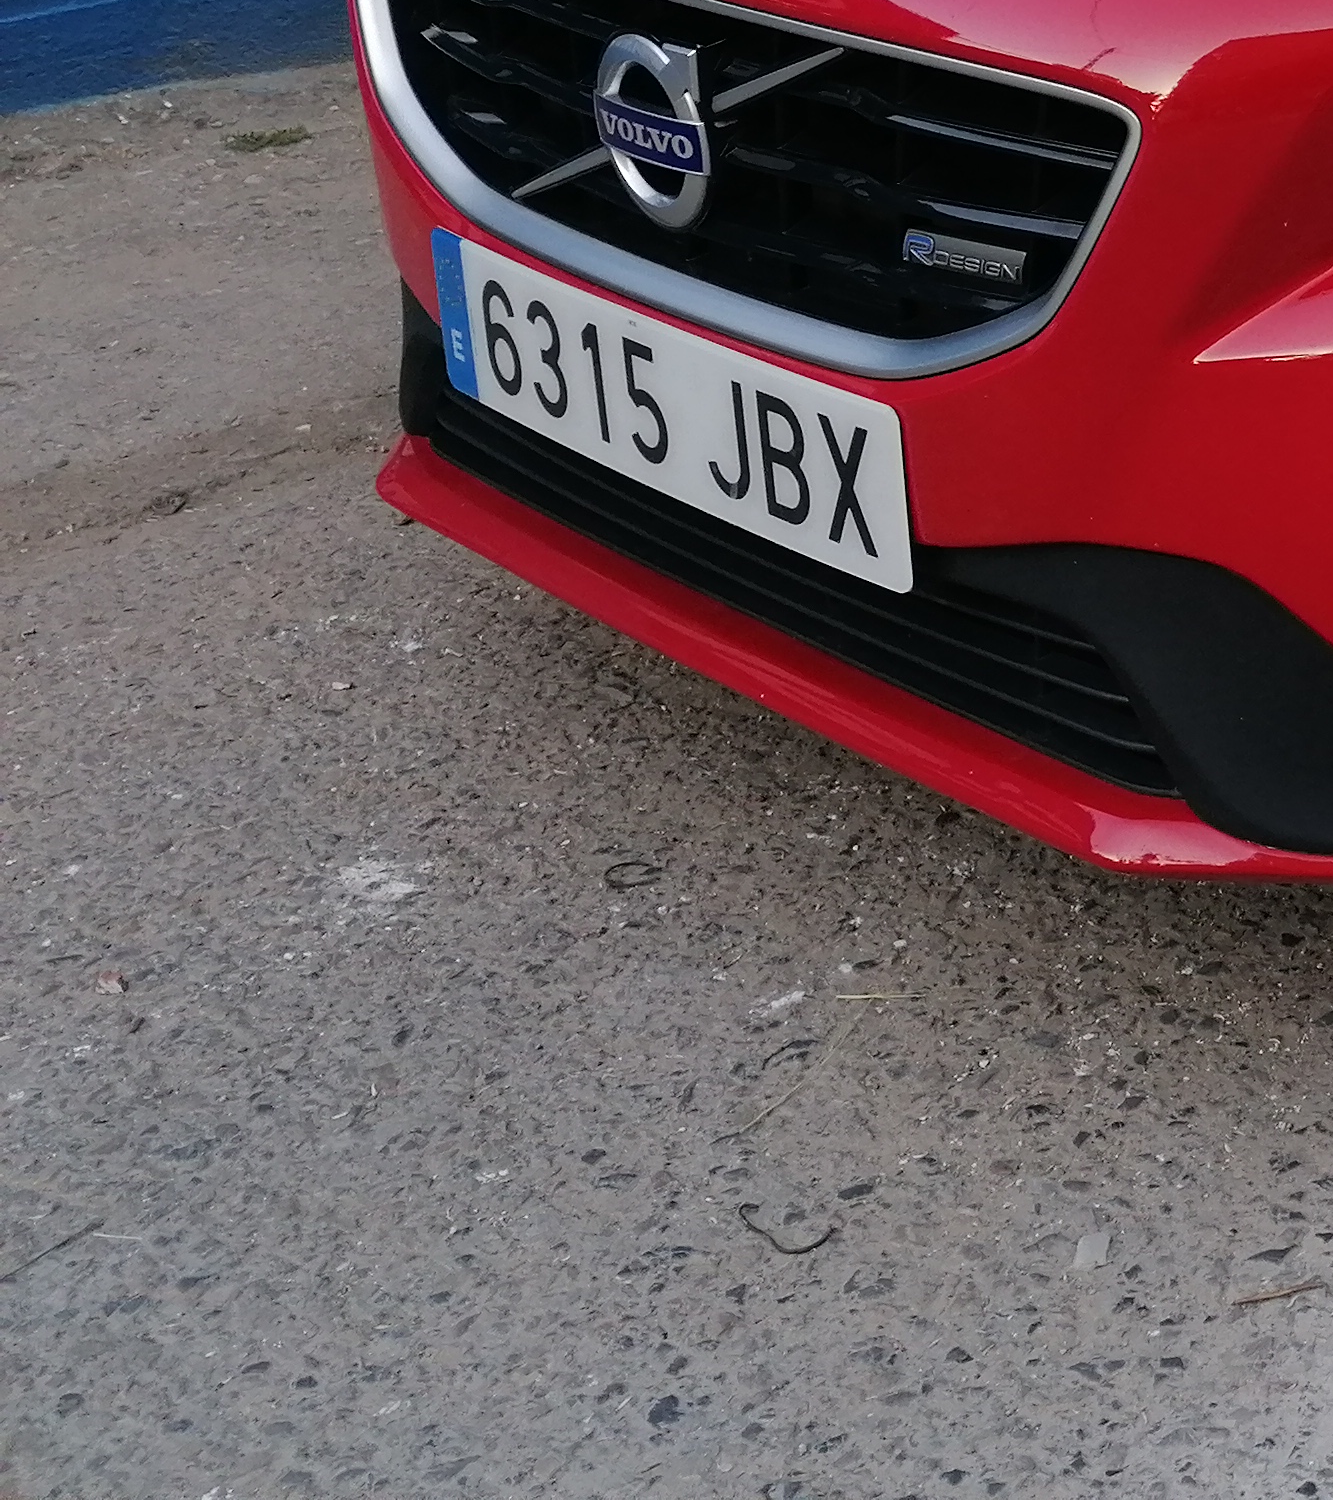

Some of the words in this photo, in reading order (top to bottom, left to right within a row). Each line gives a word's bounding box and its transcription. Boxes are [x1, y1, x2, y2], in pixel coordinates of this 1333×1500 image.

[600, 108, 694, 159] VOLVO
[482, 279, 669, 465] 6315
[708, 380, 879, 558] JBX
